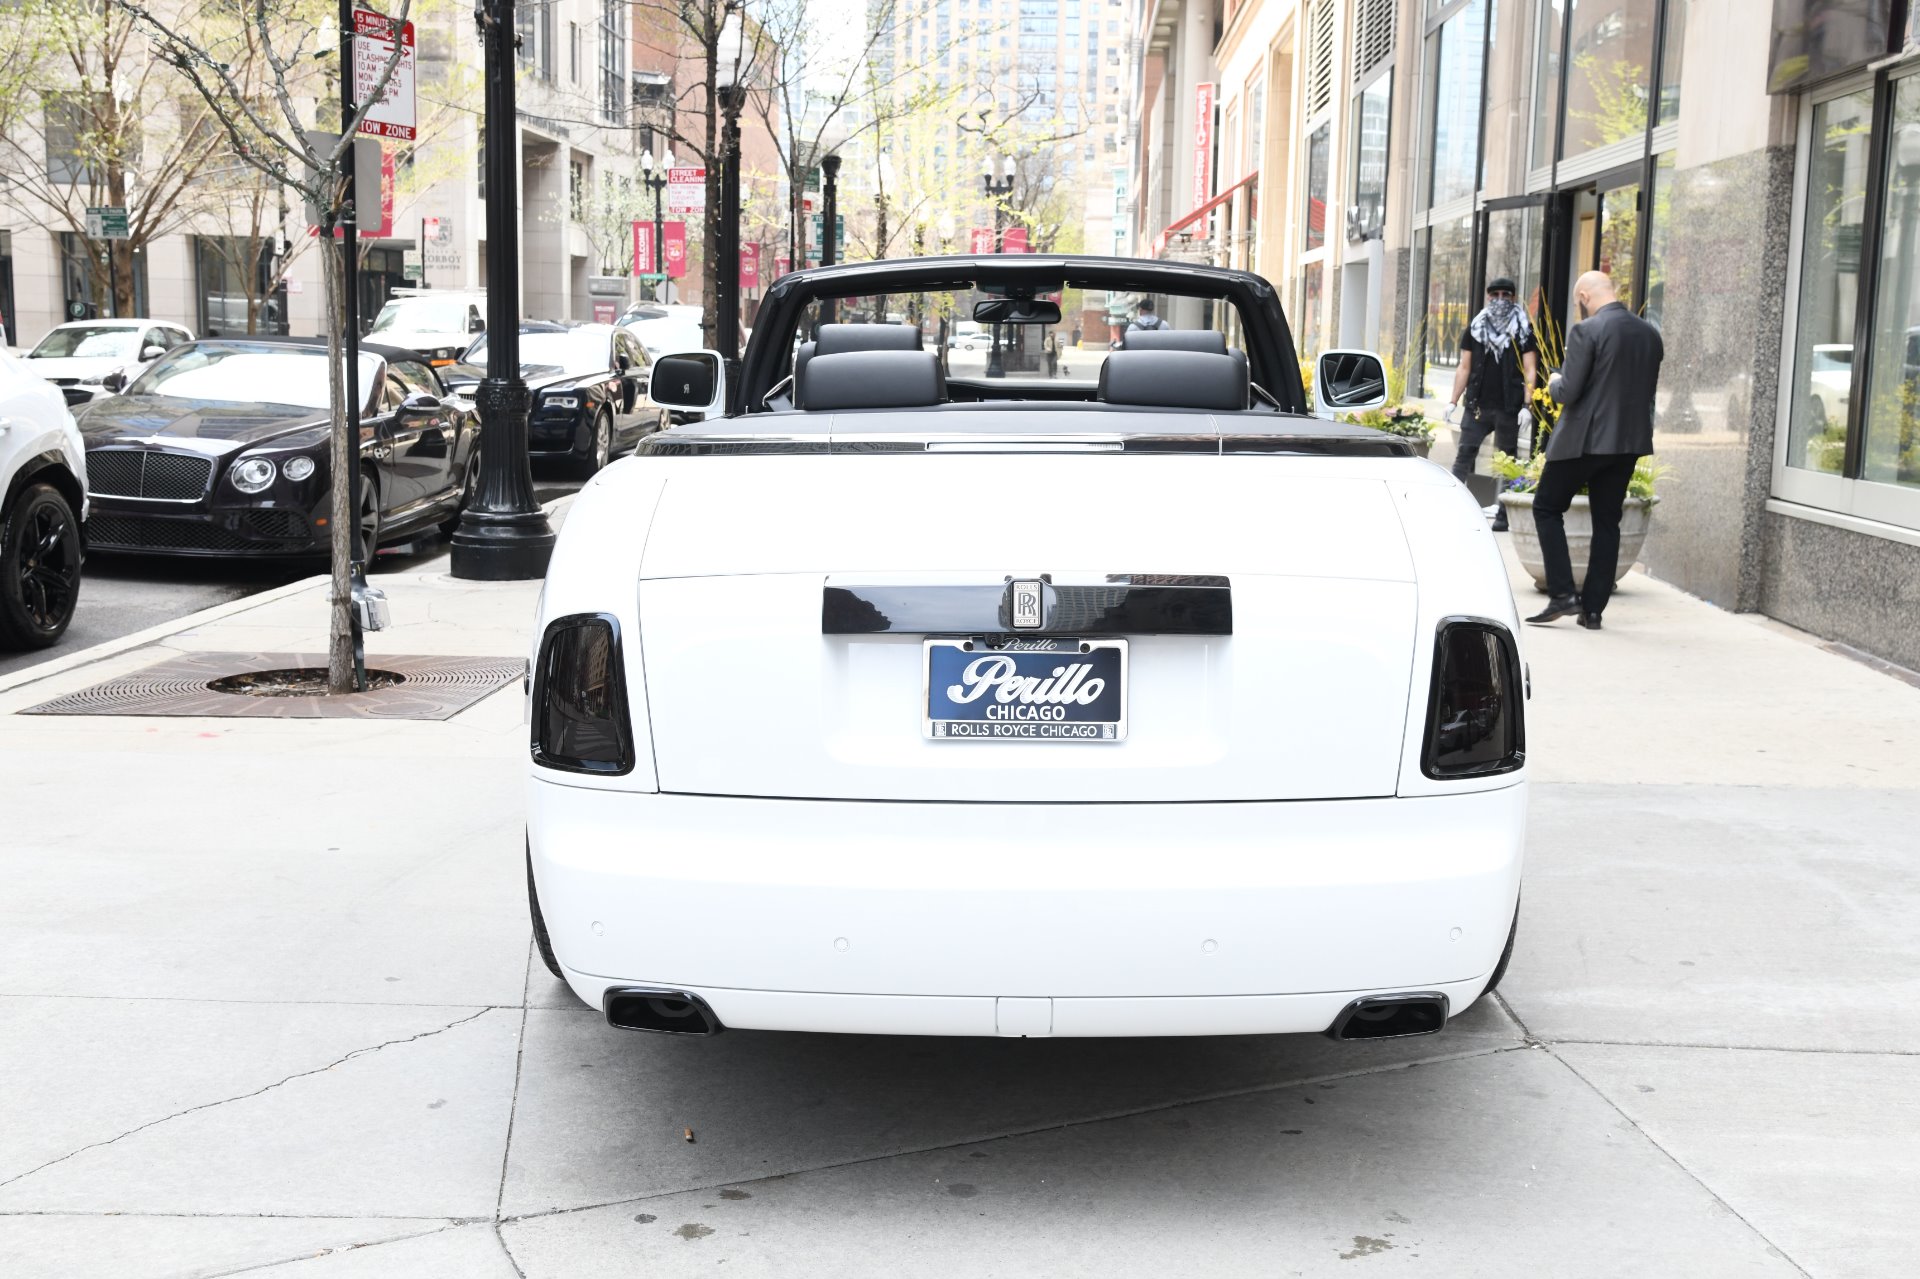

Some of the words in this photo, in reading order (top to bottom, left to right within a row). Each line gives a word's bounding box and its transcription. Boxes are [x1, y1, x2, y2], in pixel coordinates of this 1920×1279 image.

[357, 12, 364, 23] 15
[365, 15, 389, 27] MINUTE
[357, 23, 389, 38] STADING
[358, 41, 371, 51] USE
[358, 61, 365, 71] 10
[367, 63, 377, 72] AM
[358, 72, 373, 81] MON
[359, 82, 365, 91] 10
[367, 83, 377, 93] AM
[389, 88, 399, 97] PM
[360, 120, 381, 134] TOW
[385, 124, 412, 139] ZONE
[671, 169, 697, 177] STREET
[1194, 150, 1205, 232] BURGR
[638, 227, 646, 271] WELCOME
[1018, 592, 1037, 616] RR
[994, 637, 1057, 651] Perillo
[947, 655, 1106, 705] Perillo
[986, 704, 1066, 721] CHICAGO
[951, 723, 989, 736] ROLLS
[994, 724, 1037, 737] ROYCE
[1040, 725, 1098, 737] CHICAGO
